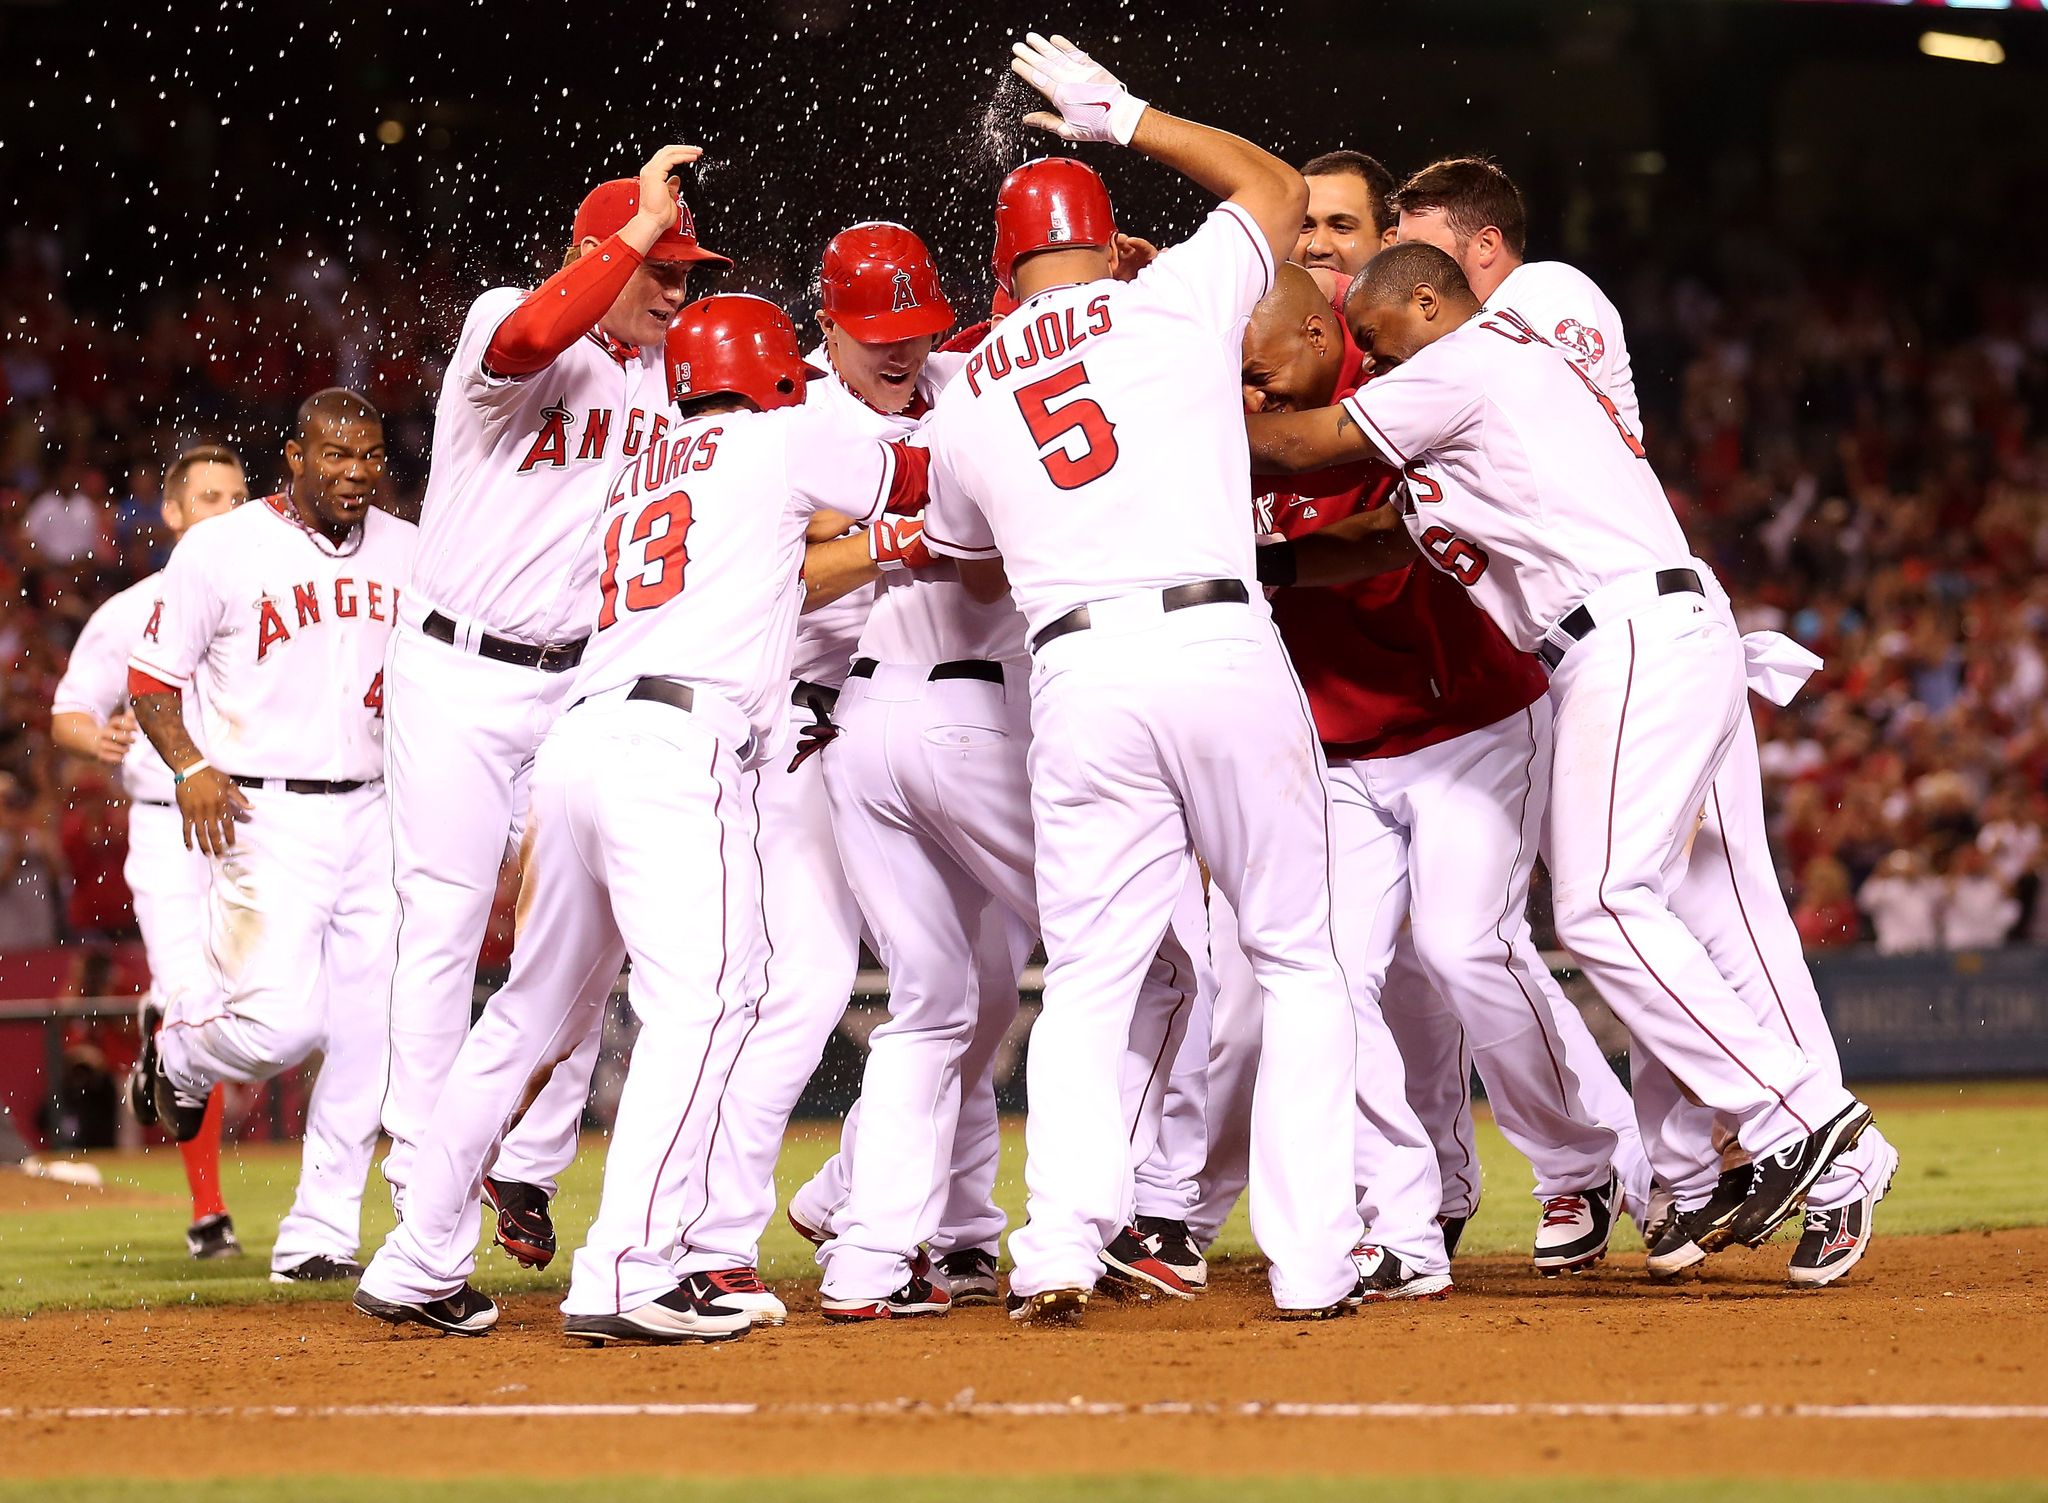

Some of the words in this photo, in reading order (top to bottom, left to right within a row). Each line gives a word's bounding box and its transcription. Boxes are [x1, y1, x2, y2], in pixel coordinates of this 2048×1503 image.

[891, 268, 918, 312] A
[675, 361, 691, 382] 13
[966, 294, 1113, 399] PUJOLS
[1013, 361, 1119, 490] 5
[598, 490, 696, 633] 13
[1419, 526, 1490, 587] 6
